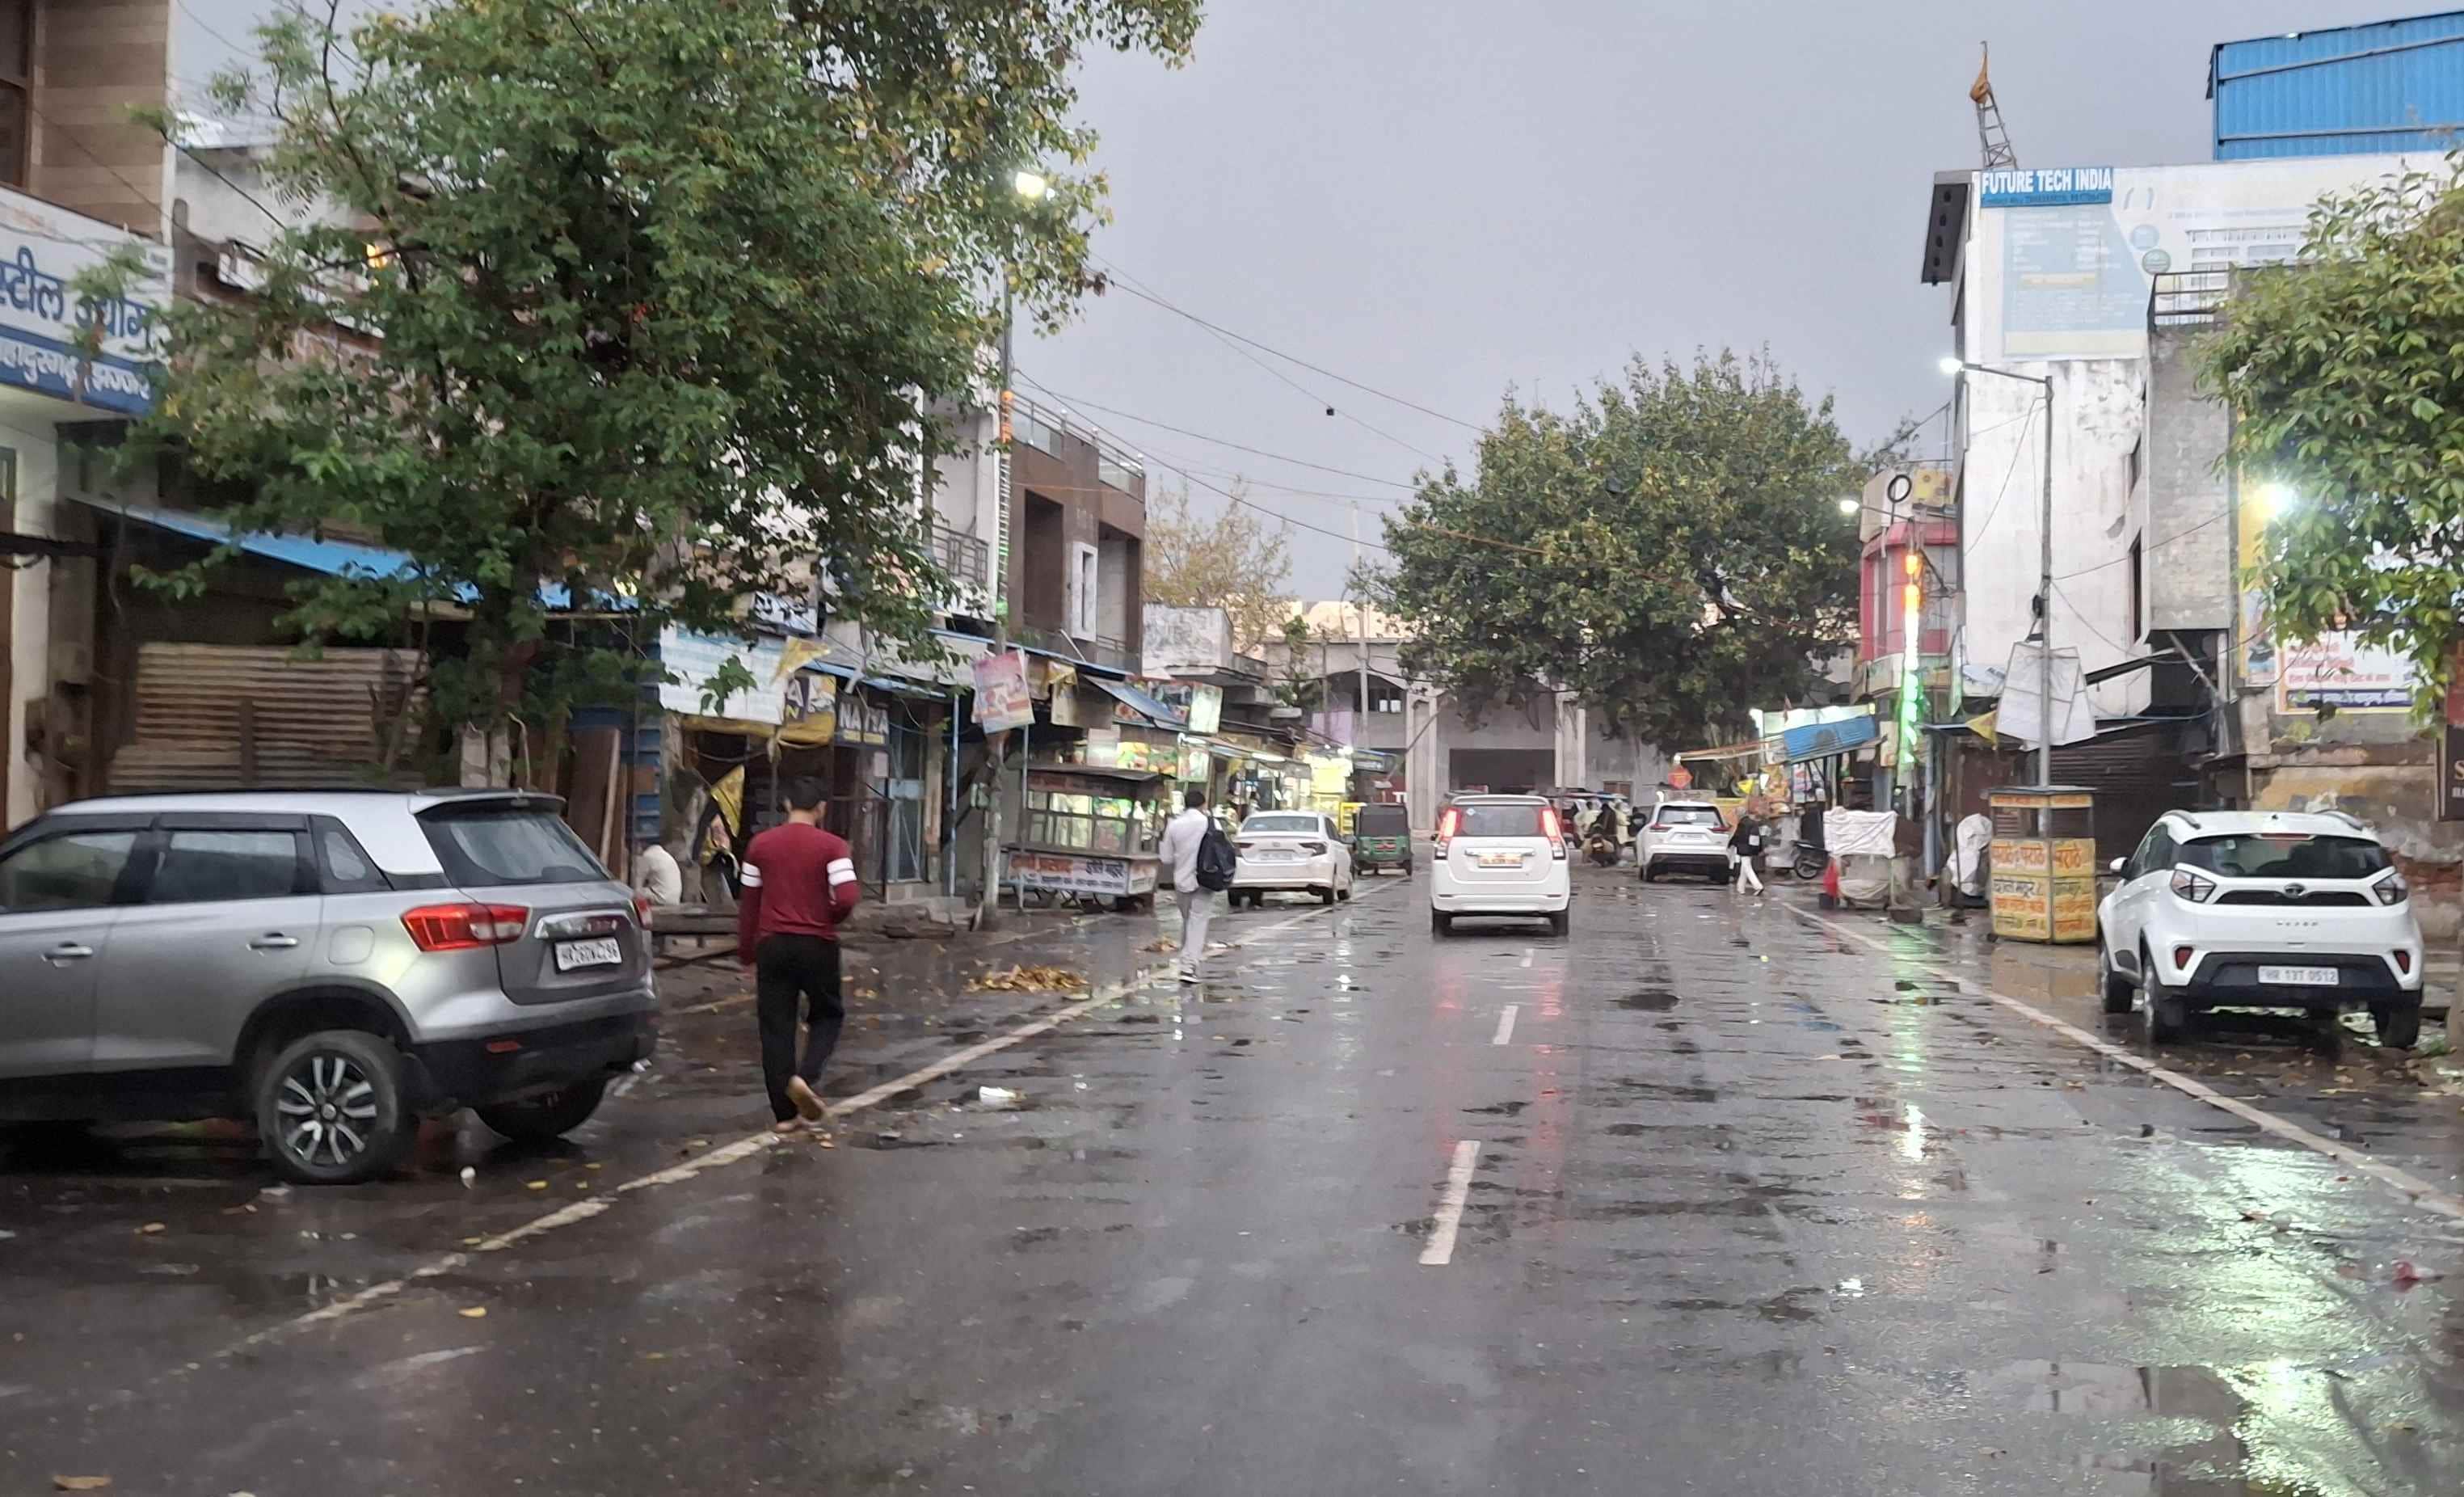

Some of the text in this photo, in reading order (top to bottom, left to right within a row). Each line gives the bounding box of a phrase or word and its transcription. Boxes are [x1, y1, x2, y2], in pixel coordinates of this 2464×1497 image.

[1982, 167, 2112, 195] FUTURE TECH INDIA
[2307, 970, 2336, 983] 0512
